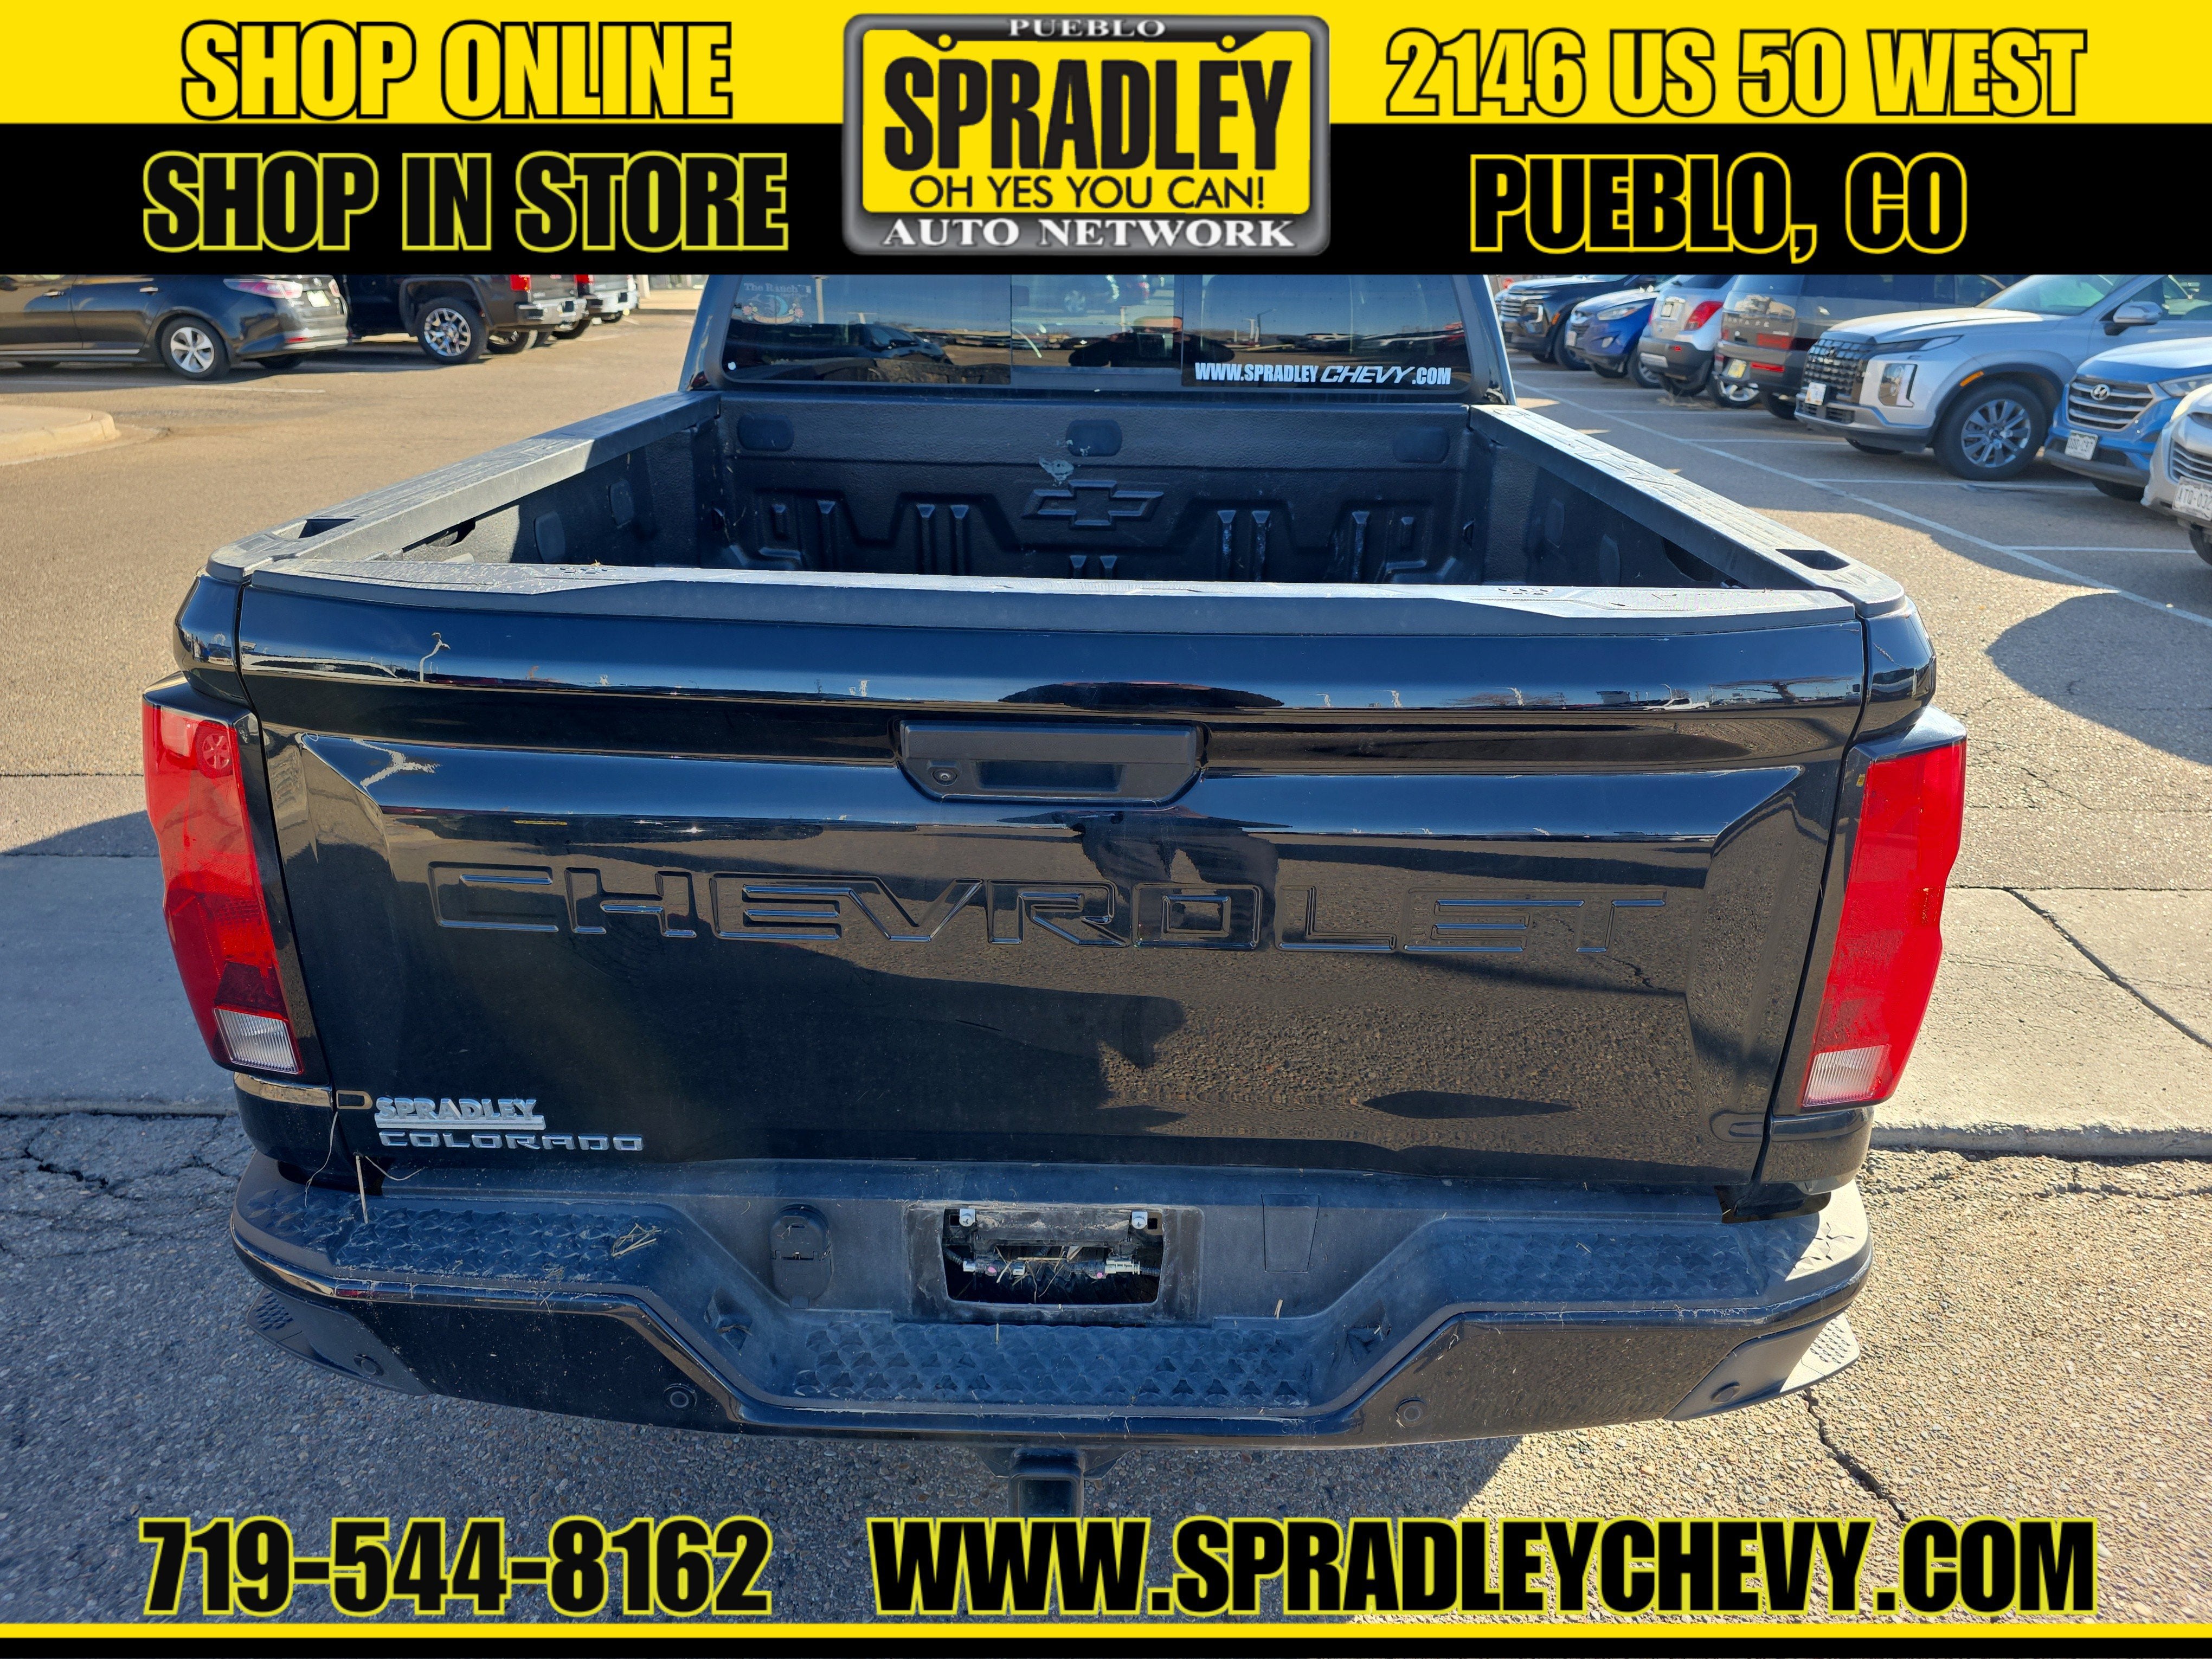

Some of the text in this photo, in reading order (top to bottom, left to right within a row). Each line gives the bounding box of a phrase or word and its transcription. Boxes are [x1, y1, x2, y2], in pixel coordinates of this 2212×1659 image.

[428, 860, 1667, 955] CHEVROLET
[375, 1096, 537, 1121] SPRADLEY
[379, 1130, 644, 1152] COLORADO
